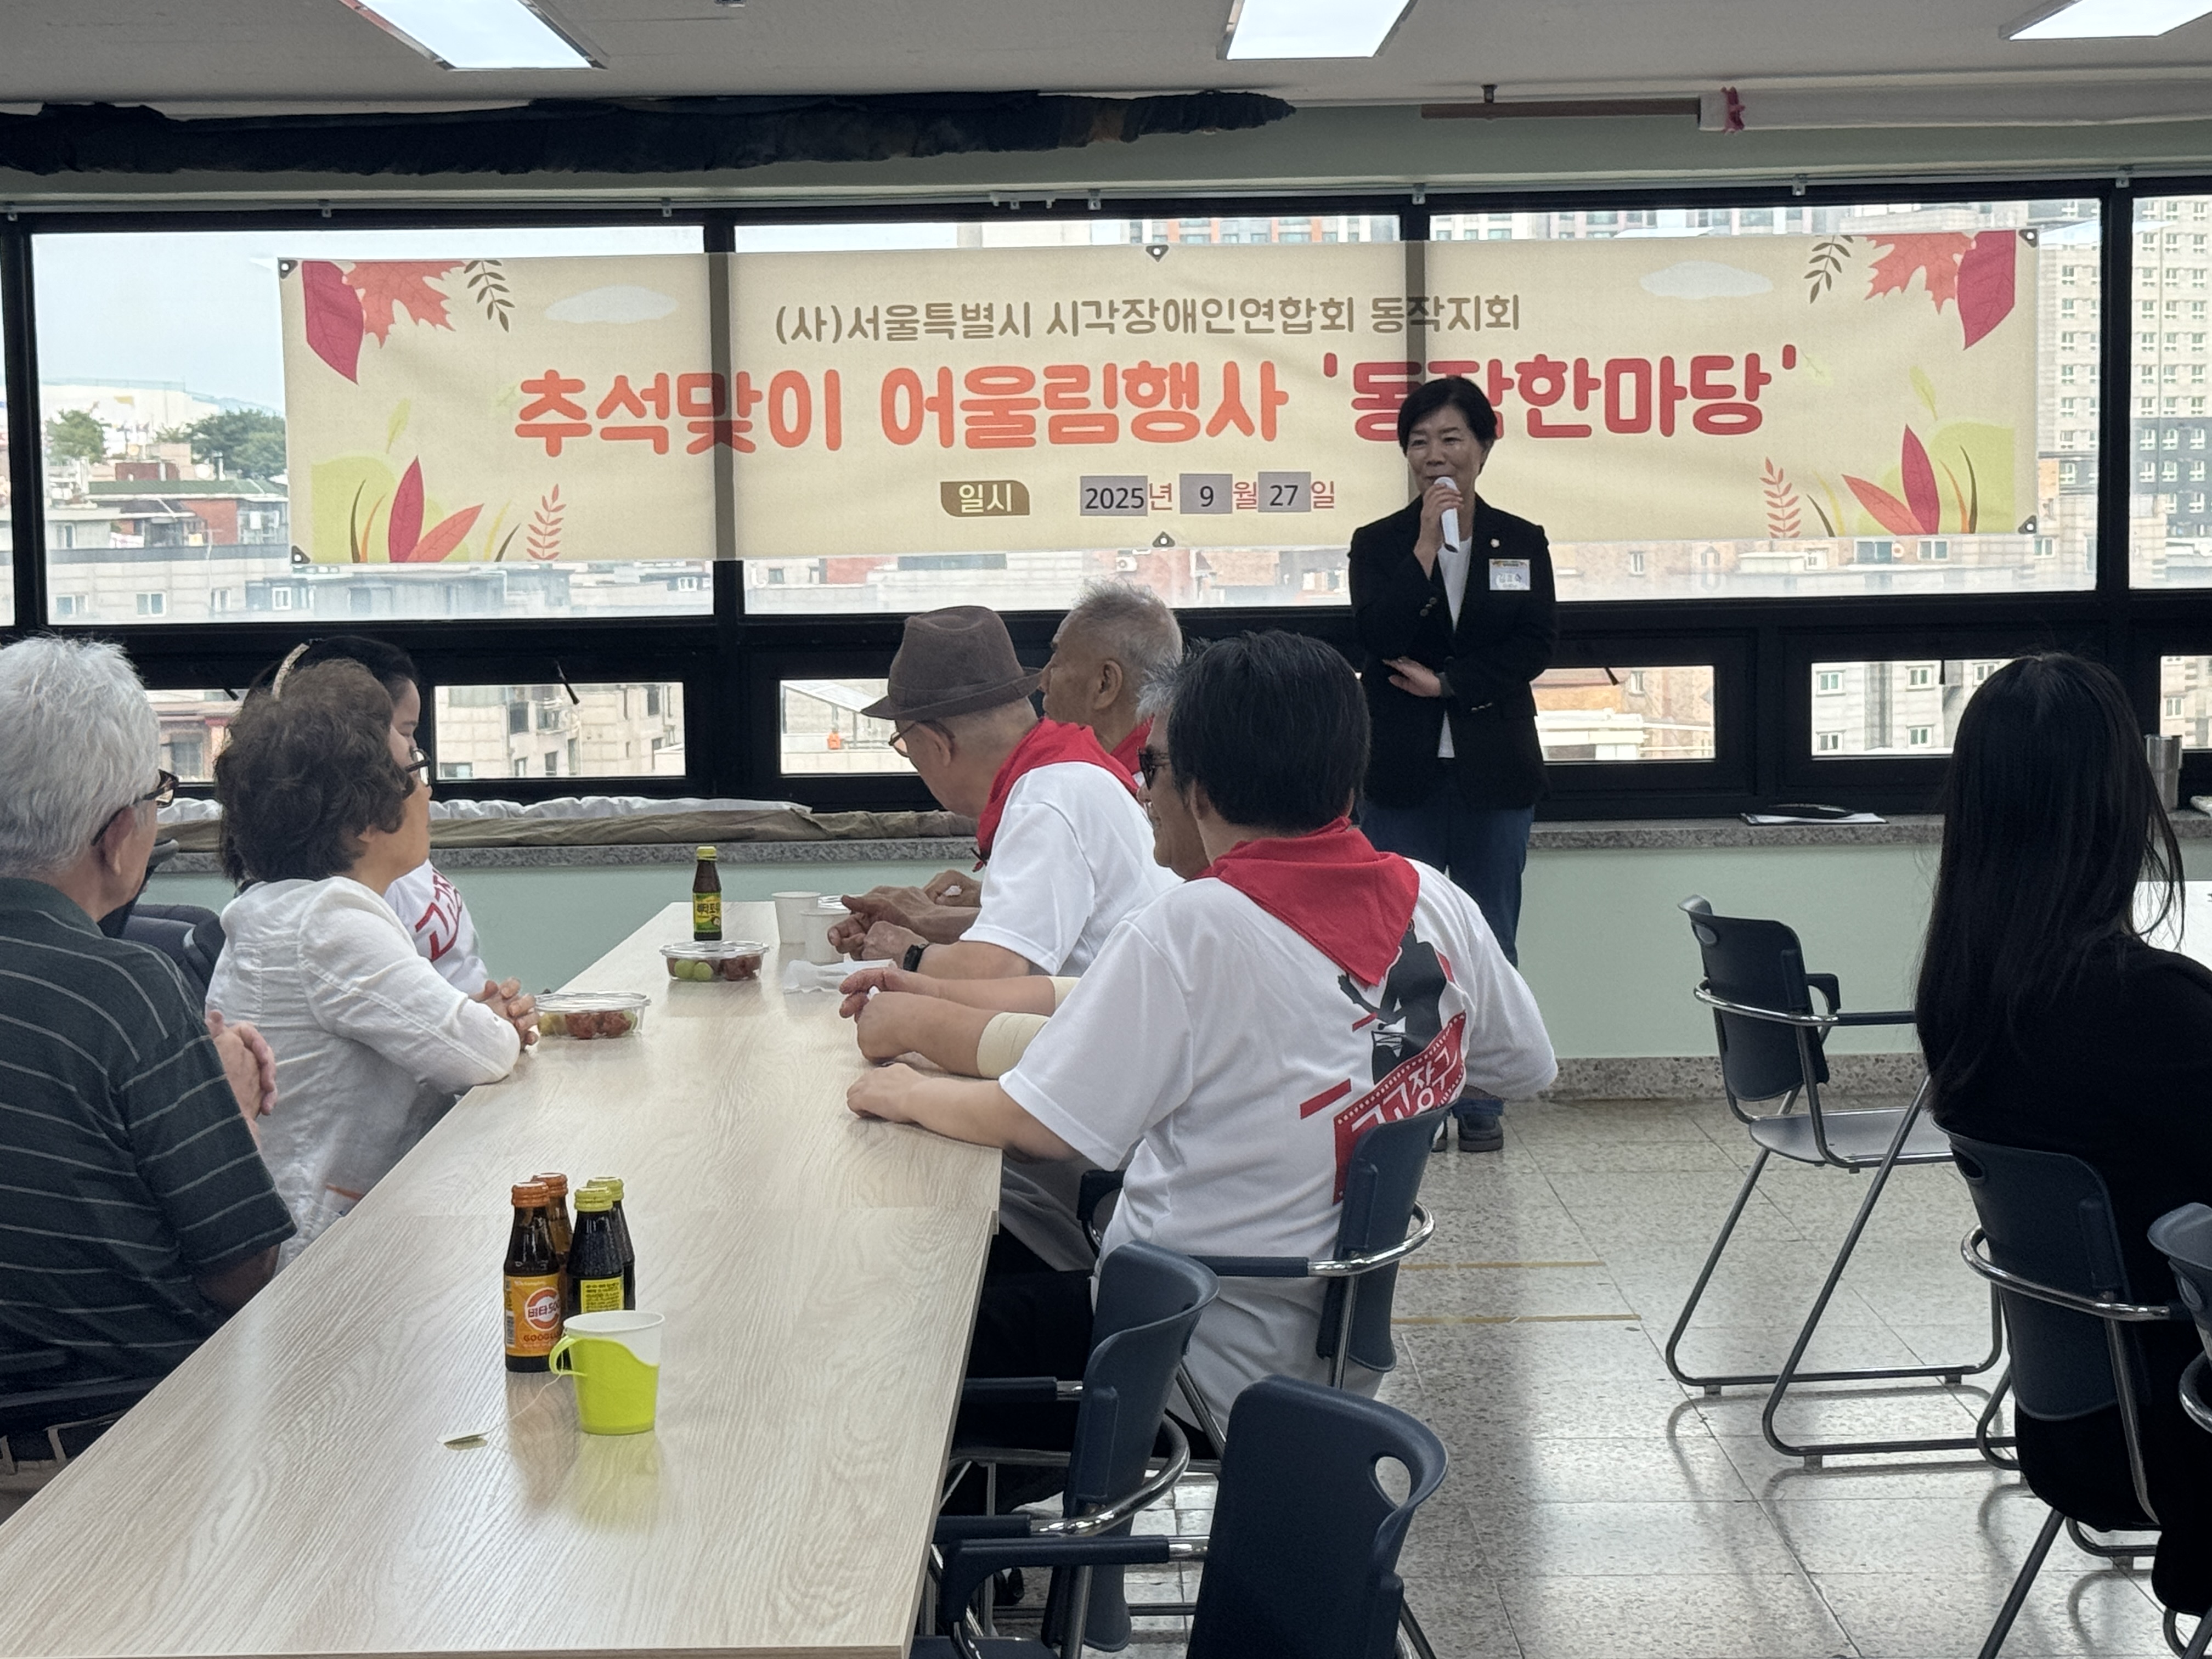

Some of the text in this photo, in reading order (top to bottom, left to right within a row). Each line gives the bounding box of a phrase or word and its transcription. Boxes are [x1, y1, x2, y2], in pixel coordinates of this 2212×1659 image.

[775, 294, 1519, 345] (사)서울특별시 시각장애인연합회 동작지회
[515, 369, 842, 458] 추석맞이
[881, 360, 1289, 449] 어울림행사
[958, 483, 1013, 514] 일시
